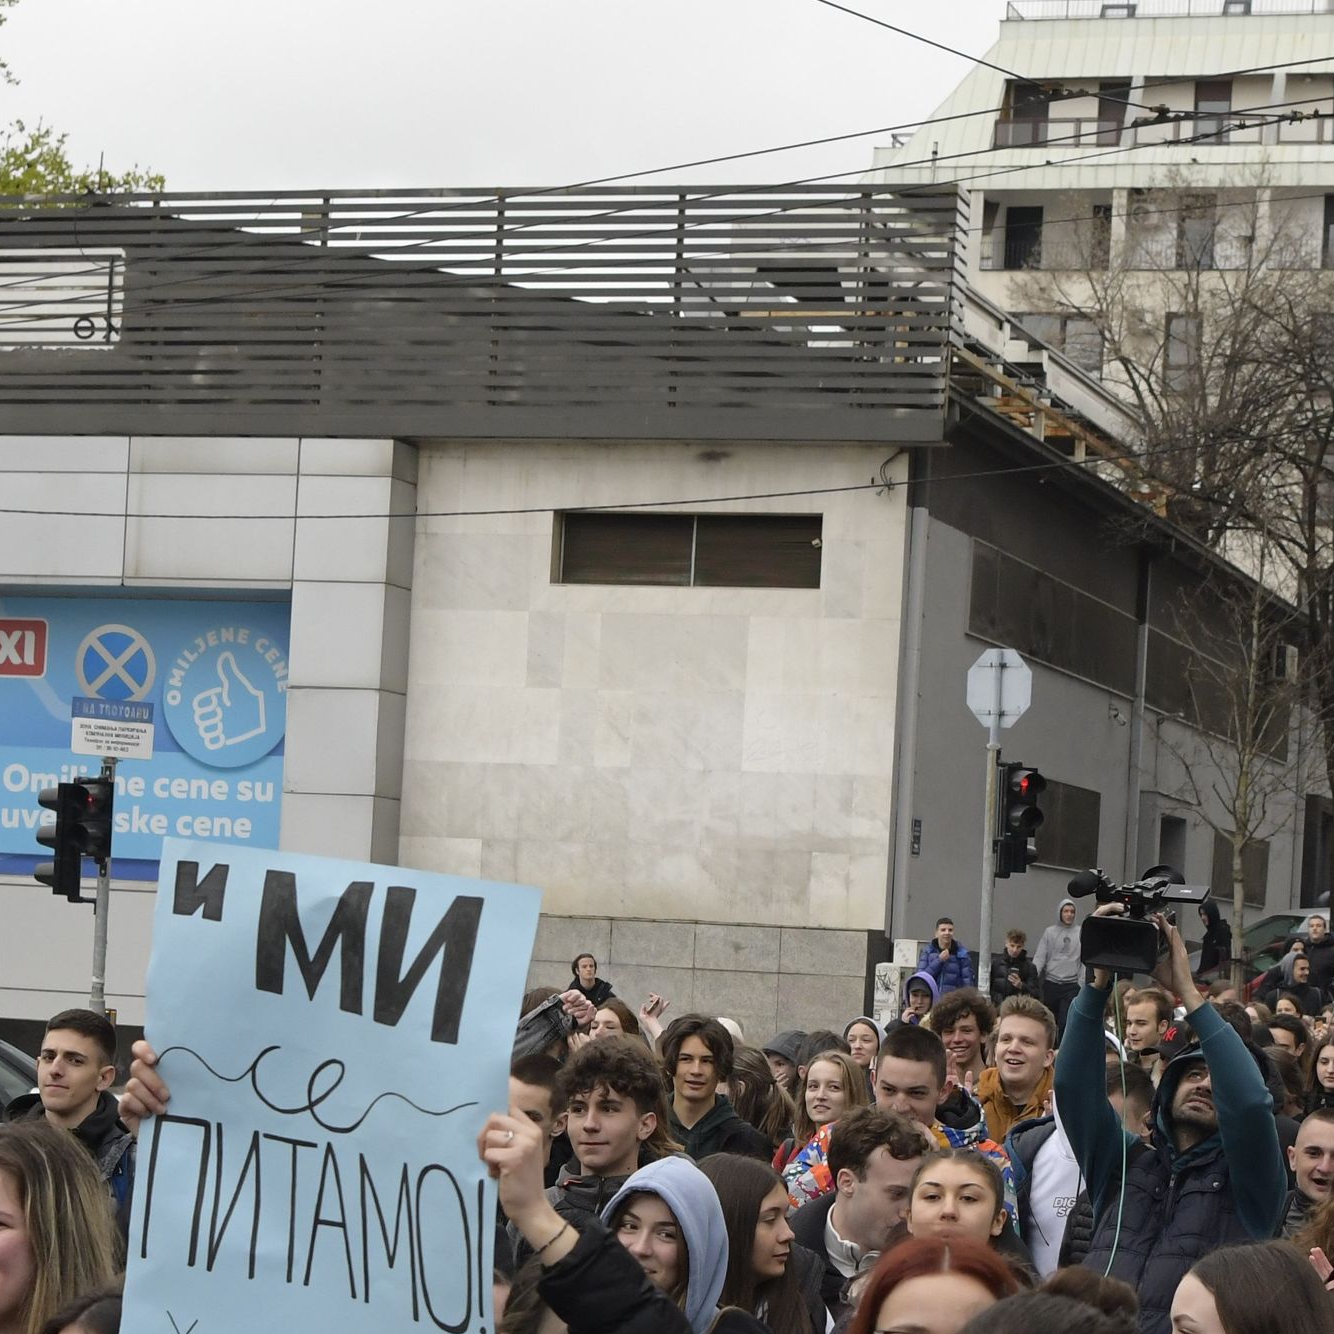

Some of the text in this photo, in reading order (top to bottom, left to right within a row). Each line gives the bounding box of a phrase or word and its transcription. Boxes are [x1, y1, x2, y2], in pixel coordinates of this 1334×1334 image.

[167, 627, 288, 706] OMILJENE CENE
[153, 777, 229, 801] cene
[237, 780, 274, 802] su
[176, 815, 252, 839] cene
[255, 869, 484, 1045] МИ
